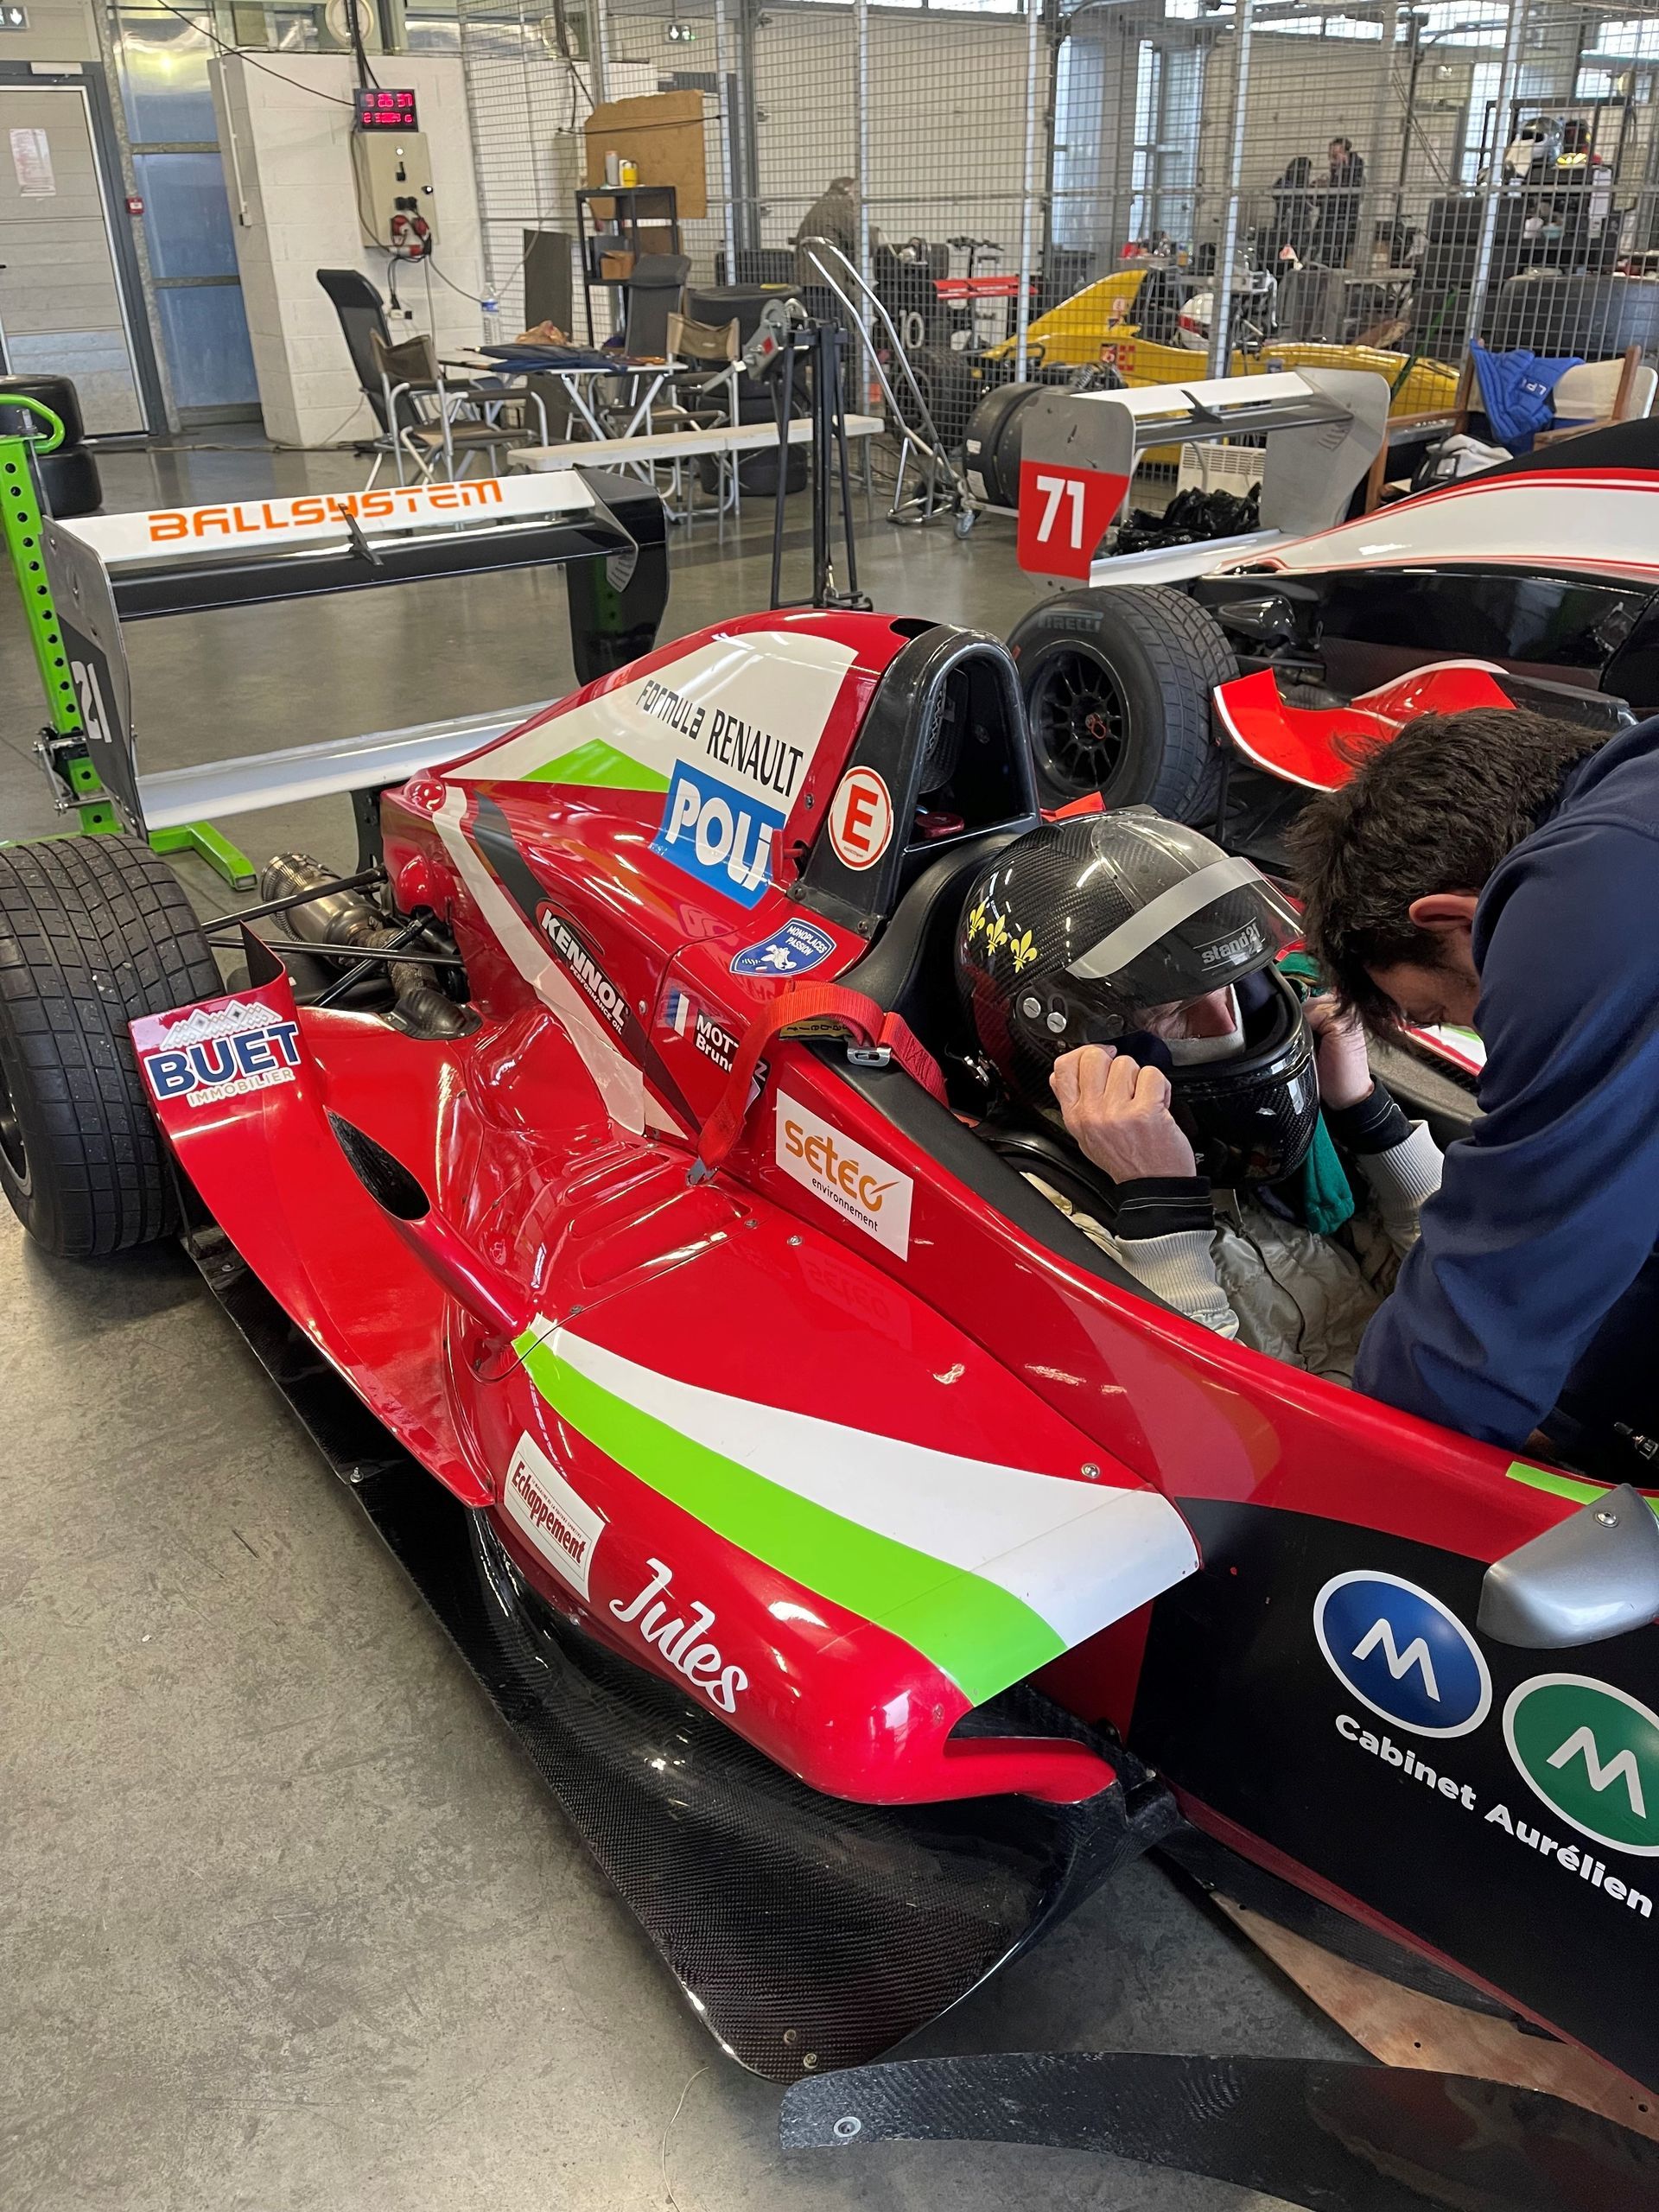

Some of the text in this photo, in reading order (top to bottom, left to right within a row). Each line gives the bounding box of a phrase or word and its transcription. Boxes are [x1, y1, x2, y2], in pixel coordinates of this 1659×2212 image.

[899, 309, 925, 349] 10
[148, 480, 503, 541] BALLSYSTEM
[1037, 474, 1085, 550] 71
[70, 660, 112, 743] 21
[706, 709, 804, 798] RENAULT
[842, 784, 879, 852] E
[541, 908, 625, 1027] KENNOL
[785, 937, 814, 957] PASSION
[786, 925, 828, 954] MONOPLACES
[569, 964, 622, 1035] PERFORMANCE OIL
[145, 1022, 300, 1099] BUET
[189, 1069, 294, 1105] IMMOBILIER
[811, 1178, 879, 1232] environnement
[512, 1460, 587, 1564] Echappement
[608, 1557, 748, 1714] Jules
[1351, 1618, 1440, 1703] M
[1546, 1726, 1647, 1820] M
[1335, 1713, 1653, 1919] Cabinet Aurélien
